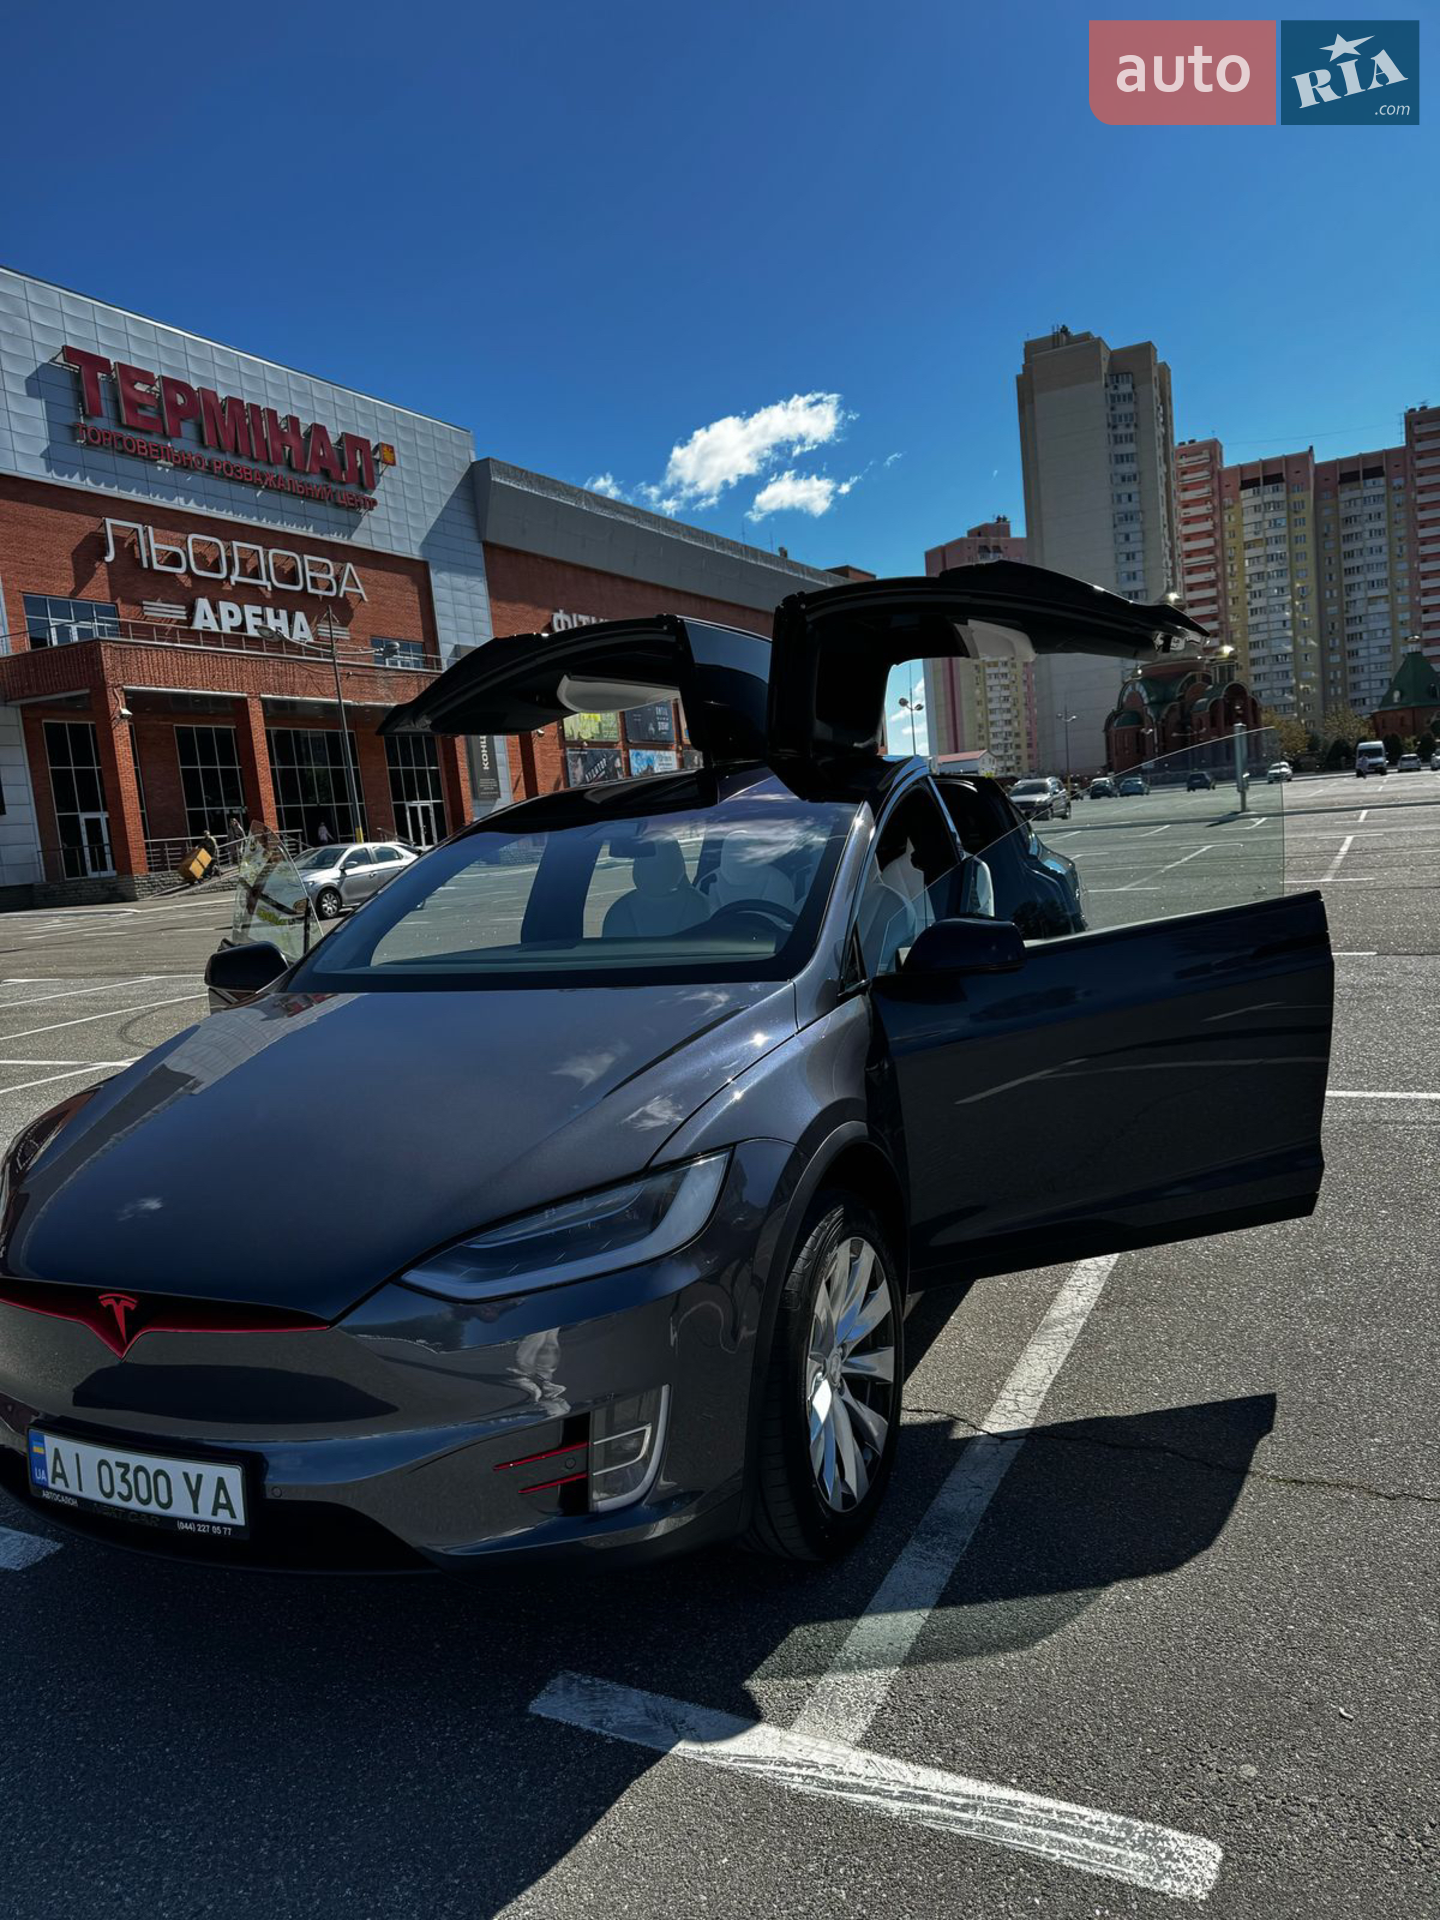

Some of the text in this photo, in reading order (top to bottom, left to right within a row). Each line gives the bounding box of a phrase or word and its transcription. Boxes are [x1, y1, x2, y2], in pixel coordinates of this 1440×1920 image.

[63, 345, 376, 490] ТЕРМІНАЛ
[337, 490, 378, 511] ЦЕНТР
[102, 517, 369, 602] ЛЬОДОВА
[191, 597, 314, 643] АРЕНА
[34, 1467, 47, 1480] UA
[51, 1447, 237, 1519] AI 0300 YA
[177, 1520, 196, 1532] (044)
[196, 1524, 210, 1533] 227
[222, 1527, 232, 1536] 77
